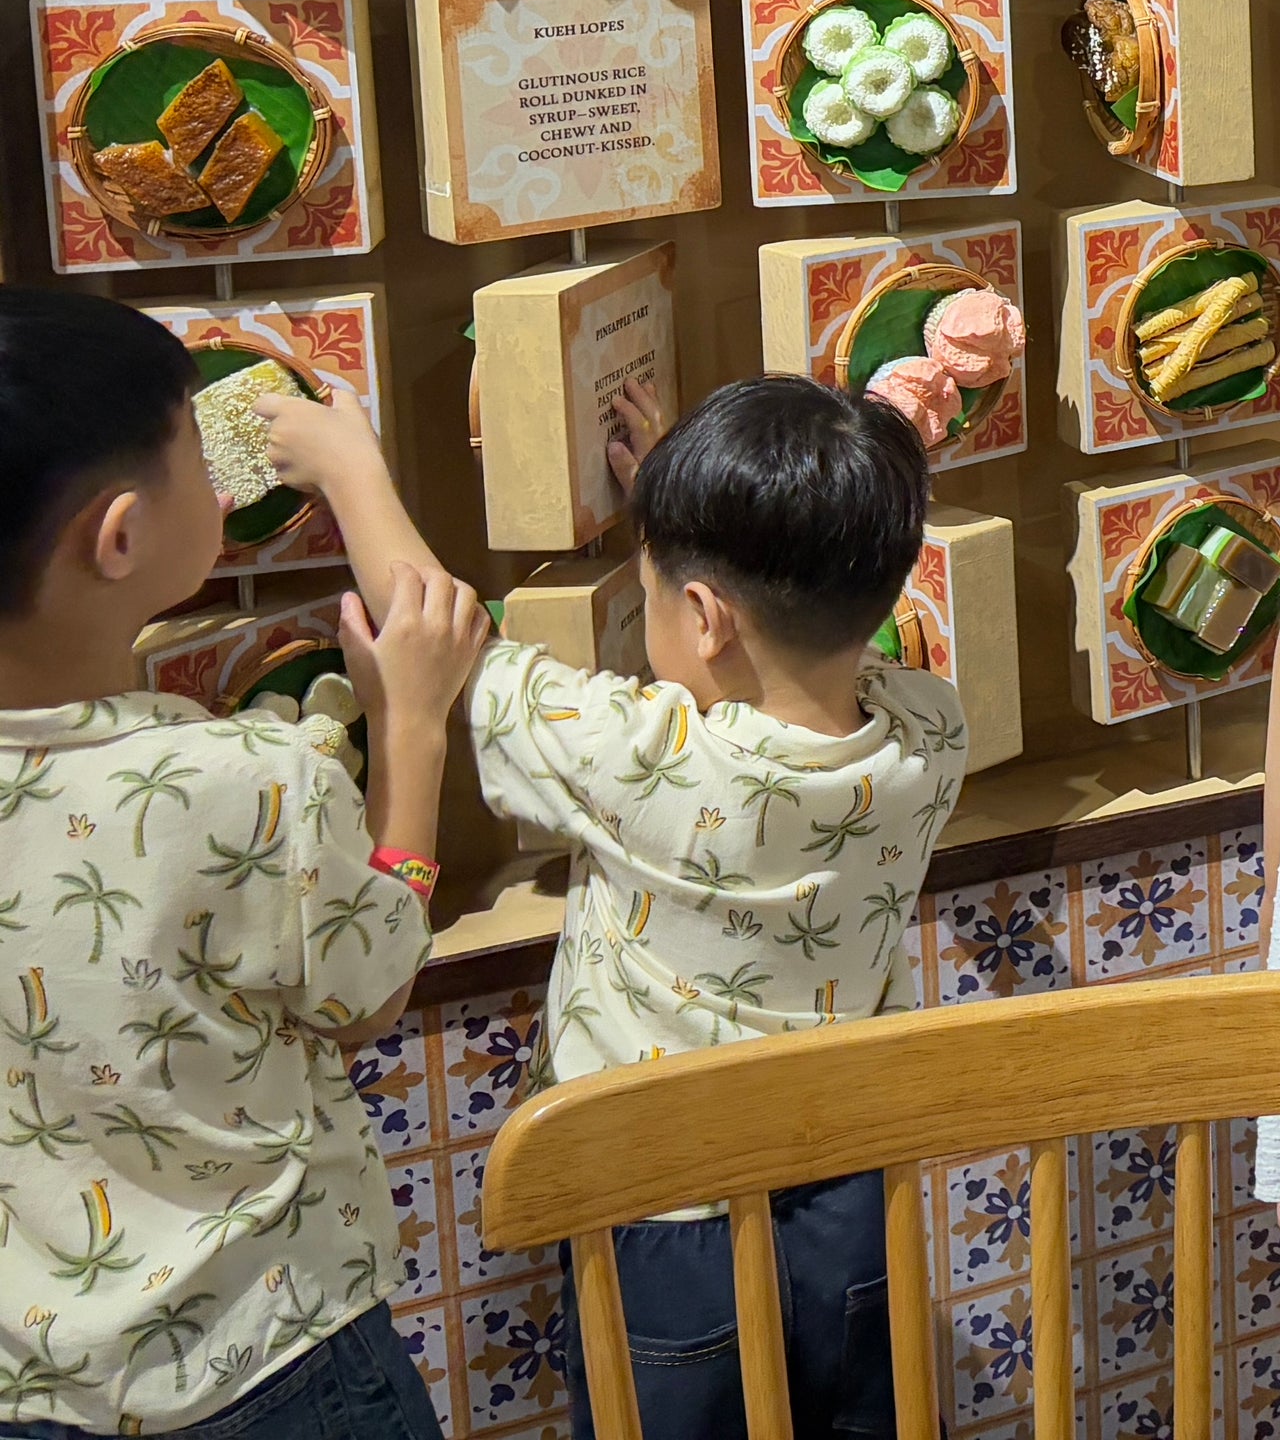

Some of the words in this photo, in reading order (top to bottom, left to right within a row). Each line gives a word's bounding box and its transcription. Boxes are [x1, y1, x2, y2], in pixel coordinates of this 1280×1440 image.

[533, 24, 576, 40] KUEH
[580, 19, 625, 36] LOPES
[518, 69, 609, 91] GLUTINOUS
[613, 65, 647, 81] RICE
[519, 92, 559, 109] ROLL
[562, 86, 627, 105] DUNKED
[630, 83, 647, 97] IN
[540, 125, 597, 142] CHEWY
[599, 120, 632, 135] AND
[518, 135, 656, 162] COCONUT-KISSED.
[596, 315, 632, 342] PINEAPPLE
[632, 305, 649, 326] TART
[594, 366, 624, 393] BUTTERY
[625, 349, 656, 376] CRUMBLY
